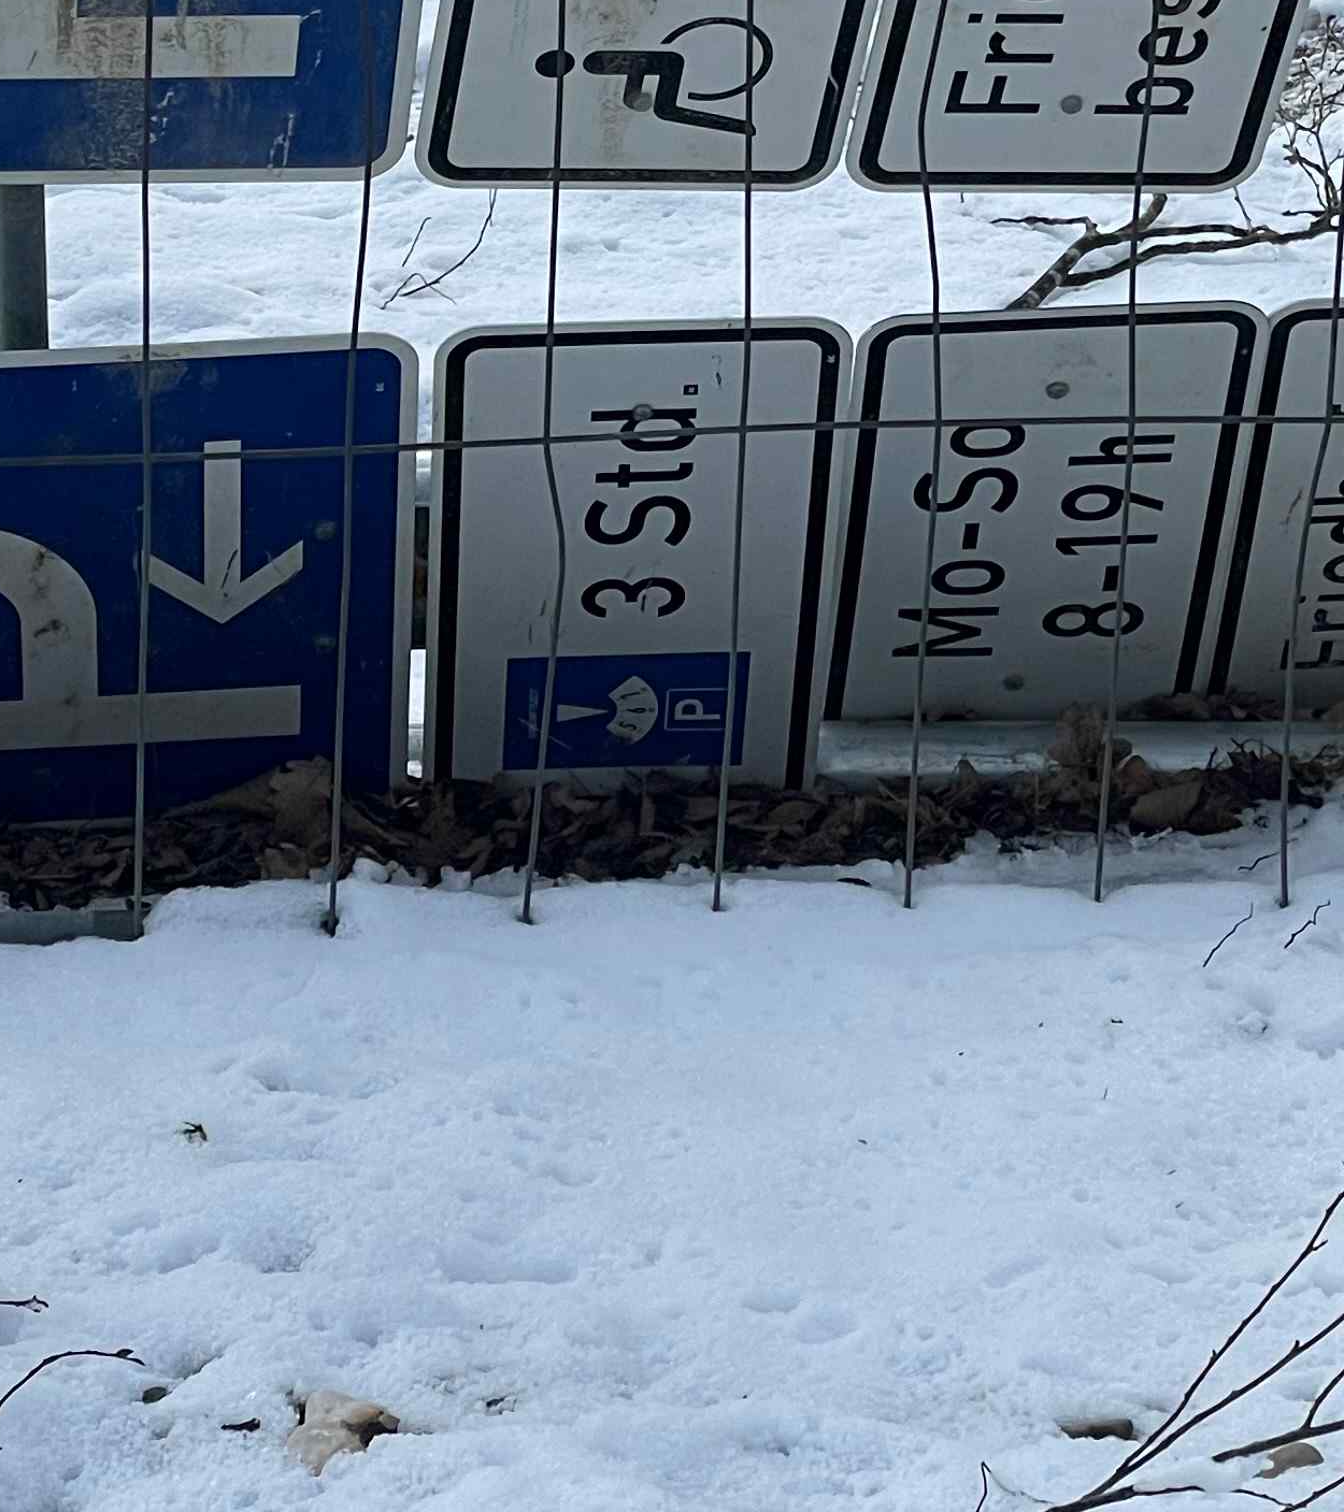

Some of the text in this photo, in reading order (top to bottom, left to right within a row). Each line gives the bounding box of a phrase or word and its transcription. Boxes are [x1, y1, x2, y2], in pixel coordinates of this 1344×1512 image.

[580, 383, 699, 619] 3 Std.
[891, 424, 1026, 658] Mo-So
